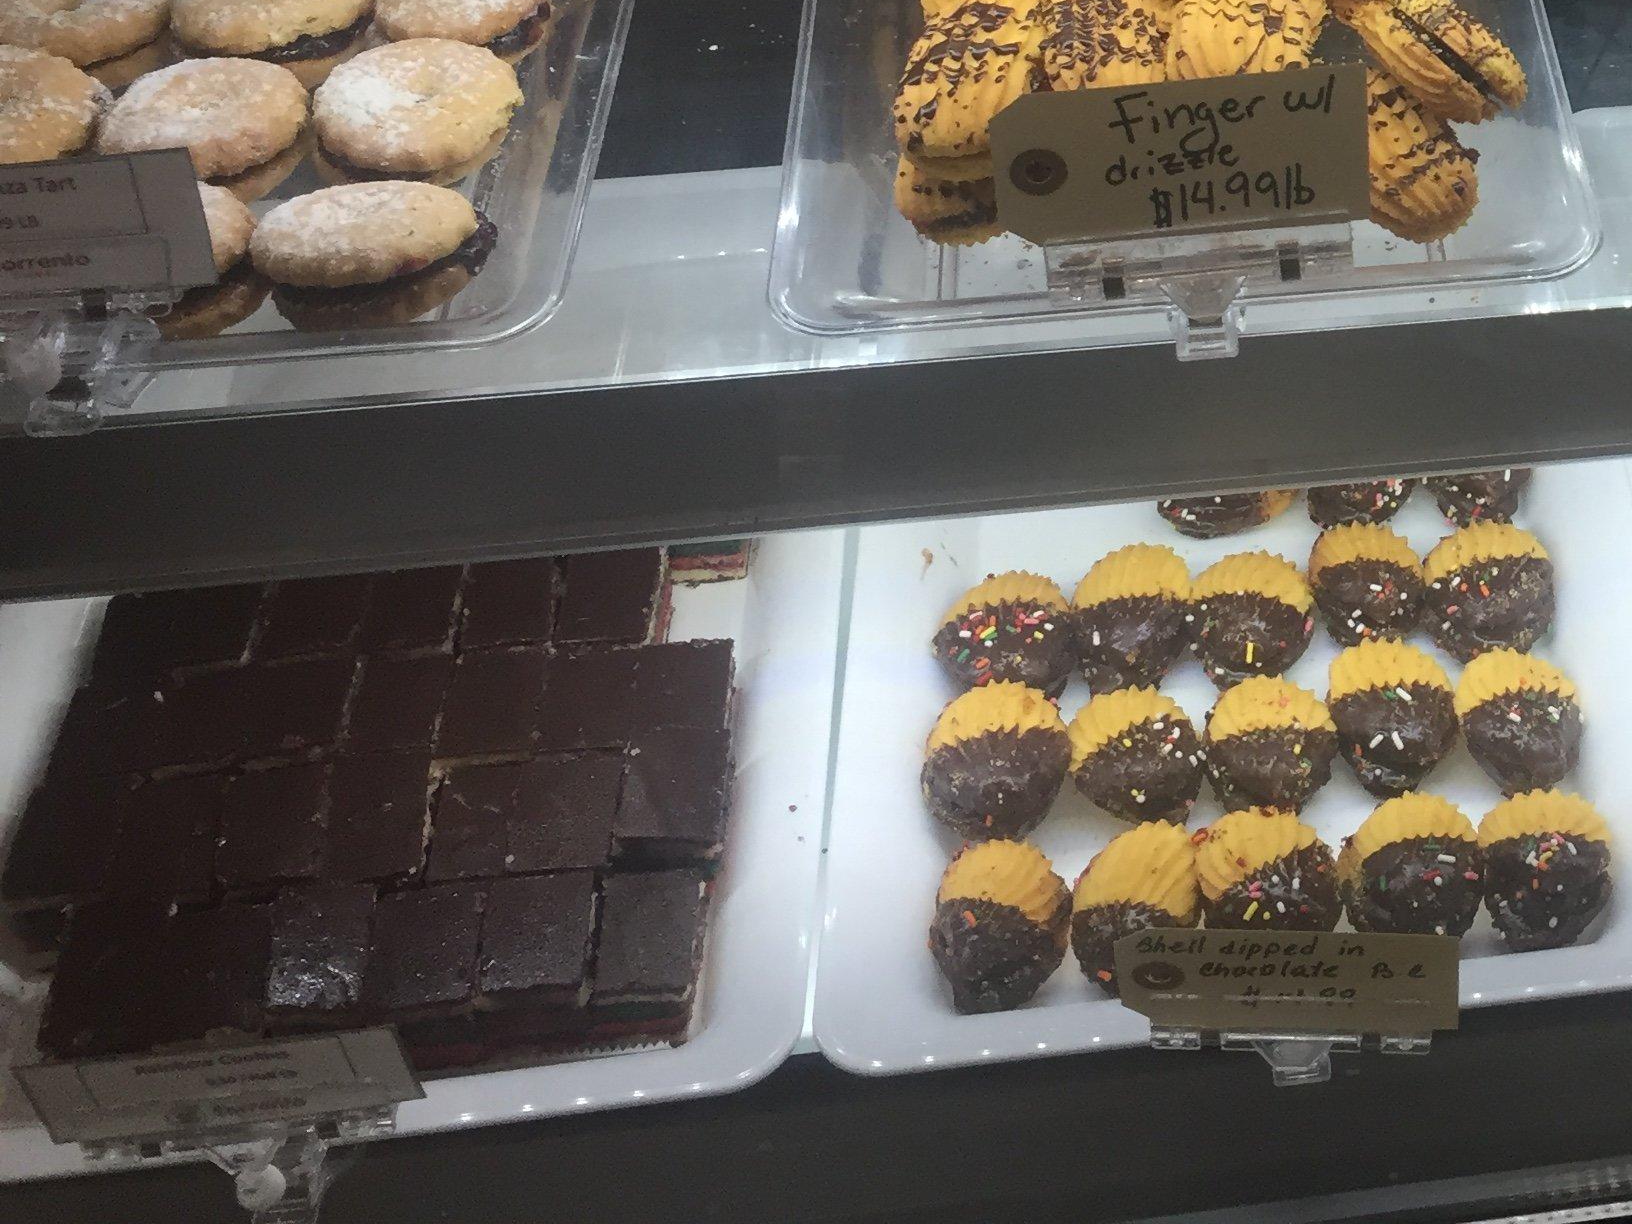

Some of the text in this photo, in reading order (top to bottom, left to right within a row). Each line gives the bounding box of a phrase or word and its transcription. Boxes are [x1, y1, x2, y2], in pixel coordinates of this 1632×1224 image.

[1108, 90, 1266, 153] Finger
[0, 253, 90, 272] orrento
[1219, 936, 1319, 960] dipped
[1337, 938, 1366, 957] in
